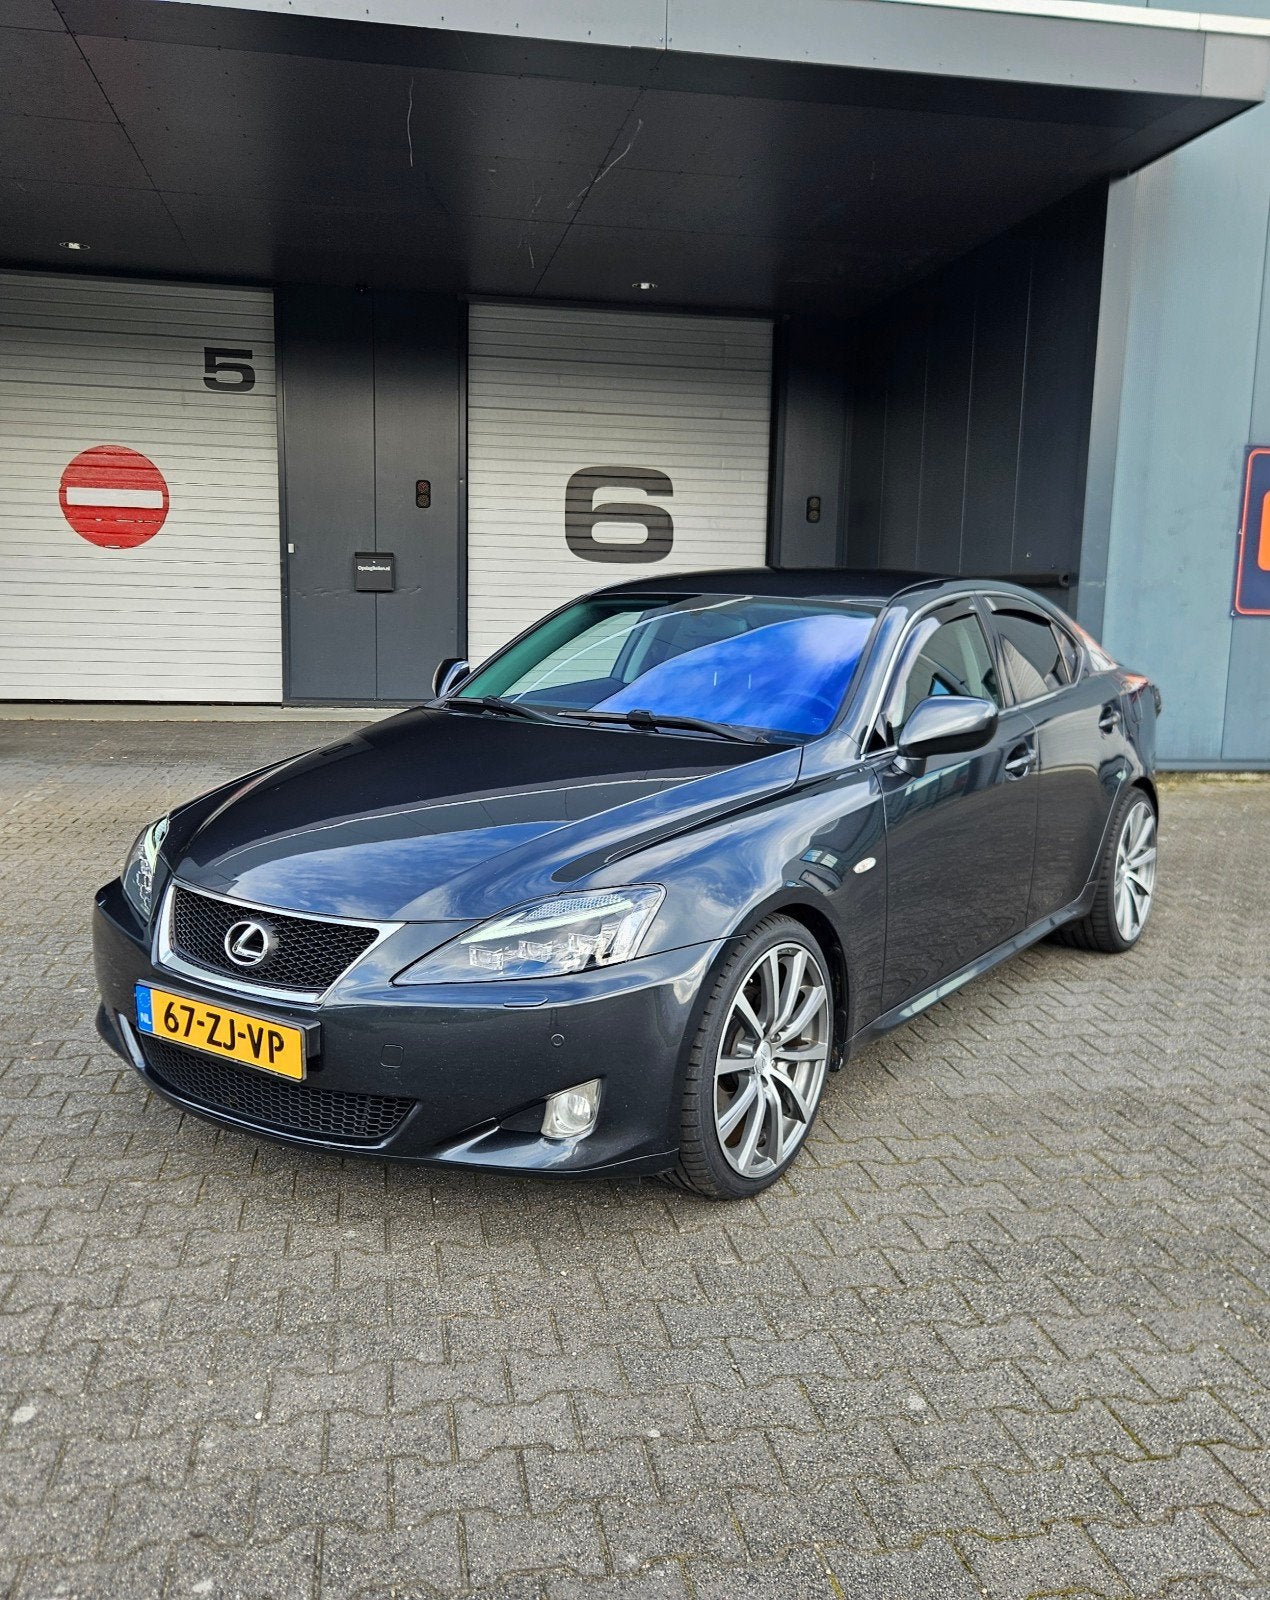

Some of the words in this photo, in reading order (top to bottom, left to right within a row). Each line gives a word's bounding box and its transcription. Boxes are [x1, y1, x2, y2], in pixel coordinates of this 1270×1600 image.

[203, 347, 255, 391] 5
[565, 466, 674, 563] 6
[140, 1011, 152, 1025] NL
[163, 1001, 285, 1064] 67-ZJ-VP
